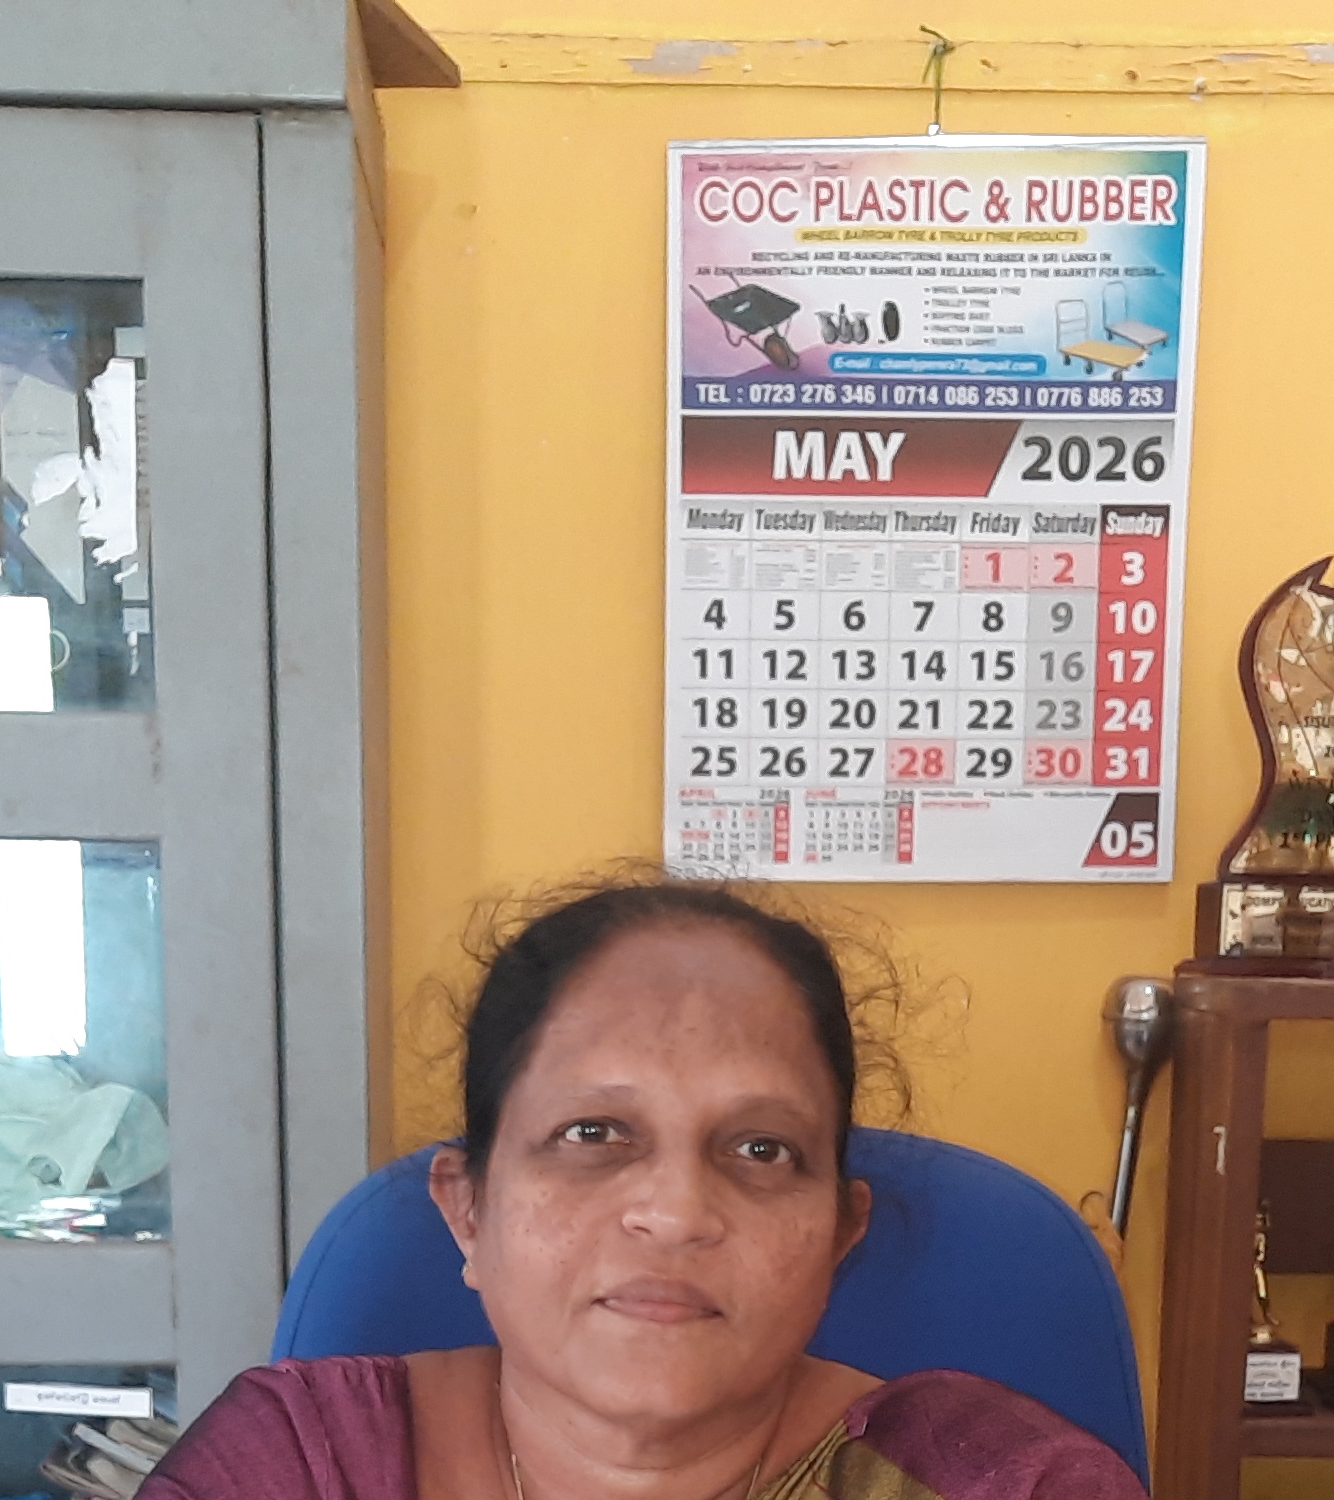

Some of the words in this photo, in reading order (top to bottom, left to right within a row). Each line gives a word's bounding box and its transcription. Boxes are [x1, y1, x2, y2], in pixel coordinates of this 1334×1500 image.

[699, 180, 799, 223] COC
[814, 179, 971, 223] PLASTIC
[984, 179, 1012, 223] &
[1025, 179, 1173, 223] RUBBER
[696, 384, 732, 404] TEL
[893, 386, 940, 406] 0714
[772, 430, 907, 482] MAY
[1020, 436, 1165, 482] 2026
[687, 508, 744, 533] Monday
[755, 508, 817, 534] Tuesday
[894, 510, 957, 535] Thursday
[970, 512, 1022, 536] Friday
[1032, 512, 1097, 536] Saturday
[1106, 511, 1166, 538] Sunday
[987, 552, 1001, 584] 1
[1052, 553, 1075, 584] 2
[1121, 552, 1145, 585] 3
[704, 599, 726, 629] 4
[774, 600, 795, 630] 5
[843, 601, 866, 631] 6
[912, 602, 935, 630] 7
[981, 602, 1004, 631] 8
[1050, 602, 1073, 632] 9
[1109, 601, 1157, 632] 10
[693, 648, 734, 679] 11
[763, 649, 808, 680] 12
[832, 650, 875, 680] 13
[901, 650, 946, 680] 14
[971, 651, 1015, 681] 15
[1039, 651, 1084, 681] 16
[1107, 649, 1154, 682] 17
[694, 698, 738, 727] 18
[763, 698, 807, 729] 19
[829, 699, 876, 729] 20
[898, 699, 942, 729] 21
[966, 700, 1013, 730] 22
[1036, 700, 1082, 730] 23
[1103, 698, 1152, 732] 24
[691, 747, 736, 776] 25
[760, 747, 806, 777] 26
[828, 748, 874, 777] 27
[897, 748, 944, 777] 28
[966, 748, 1012, 778] 29
[1034, 748, 1081, 778] 30
[1104, 747, 1150, 779] 31
[1099, 821, 1155, 859] 05
